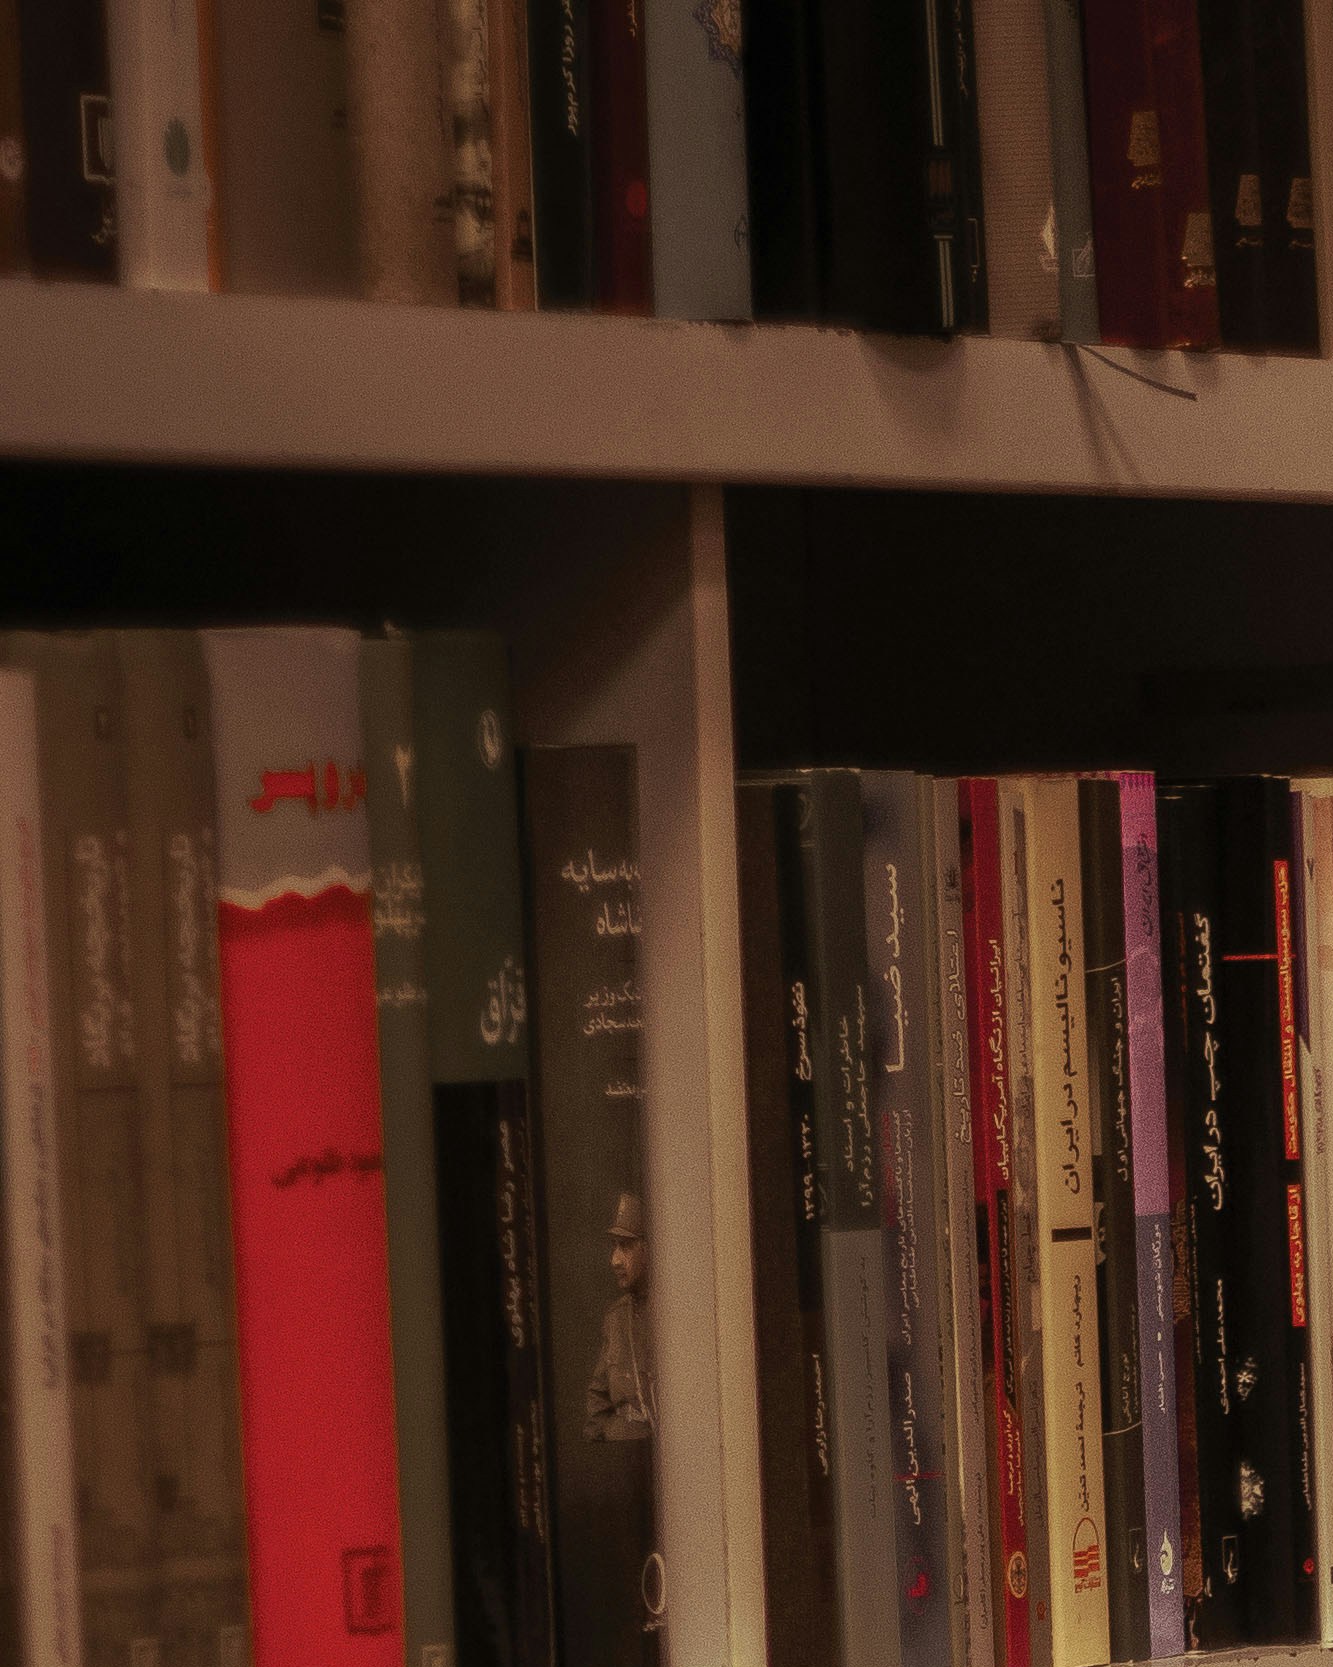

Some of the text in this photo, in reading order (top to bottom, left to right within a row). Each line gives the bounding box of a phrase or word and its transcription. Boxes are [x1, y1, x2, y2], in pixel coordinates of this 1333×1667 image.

[884, 862, 905, 957] سید
[1111, 976, 1123, 1013] ایران
[1113, 1037, 1124, 1079] جنگ
[1193, 912, 1226, 1211] گفتمان چپ در ایران
[1063, 1082, 1078, 1115] در
[1059, 1117, 1081, 1193] ایران
[1115, 1149, 1129, 1182] اول
